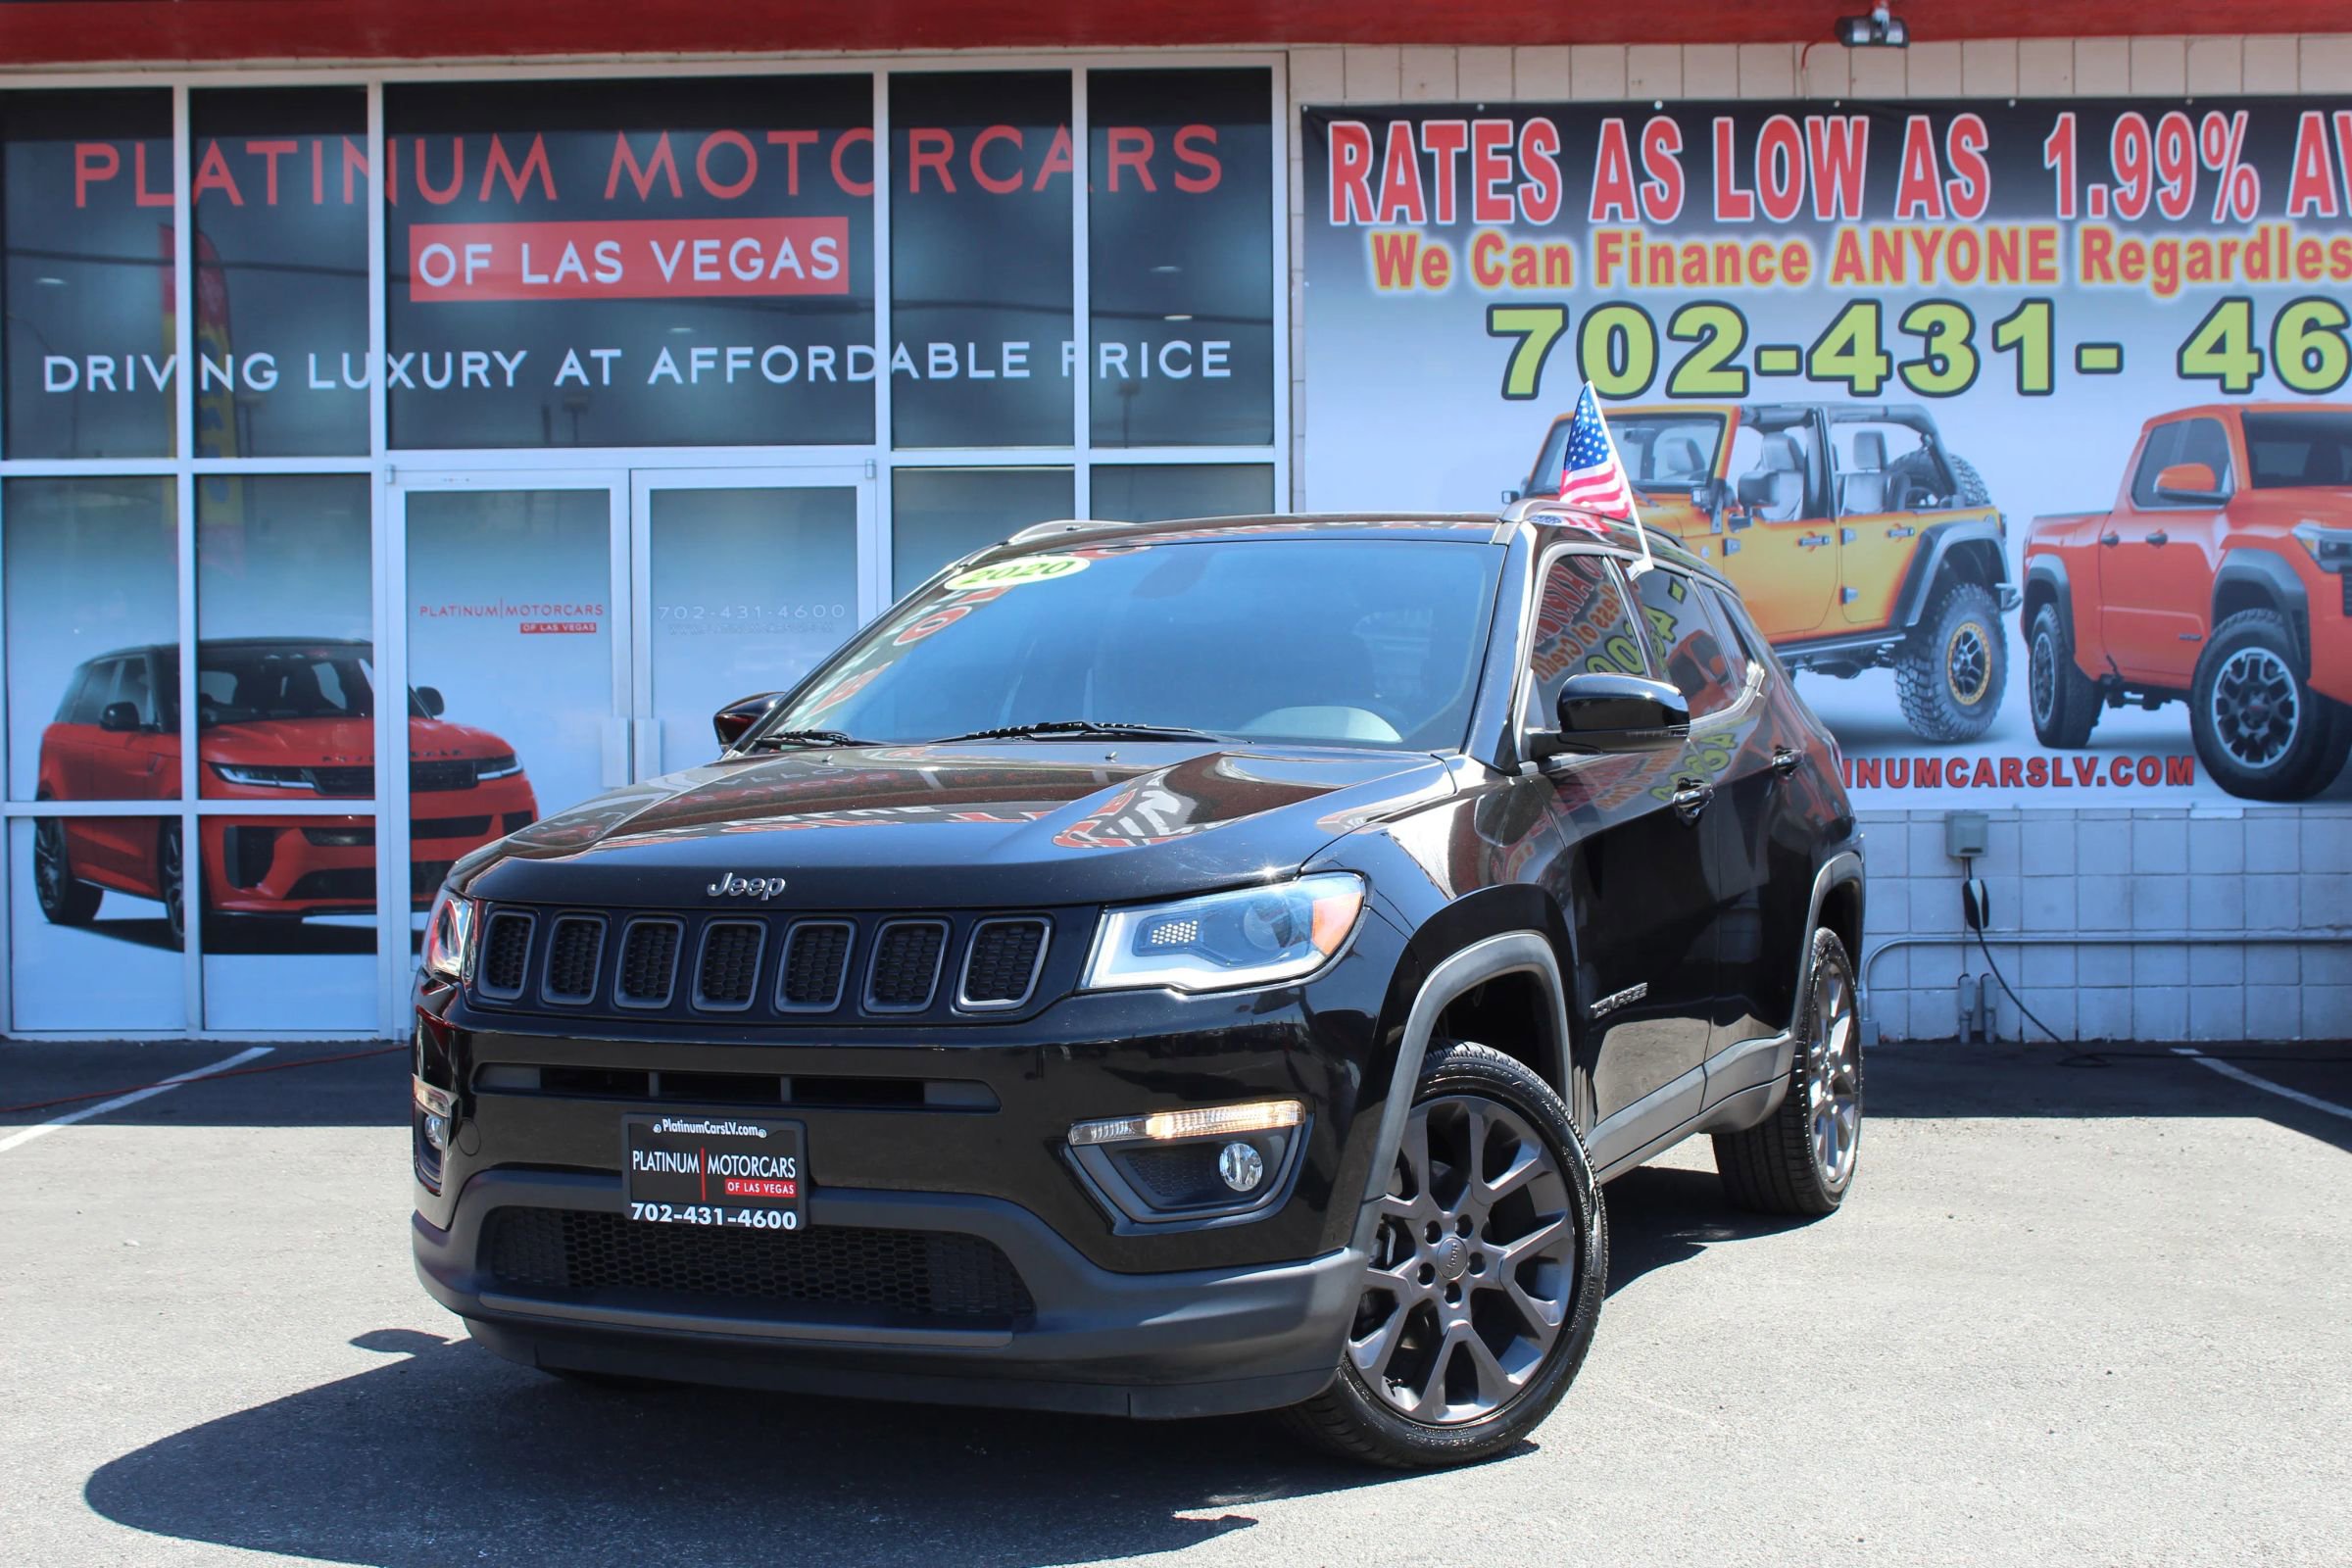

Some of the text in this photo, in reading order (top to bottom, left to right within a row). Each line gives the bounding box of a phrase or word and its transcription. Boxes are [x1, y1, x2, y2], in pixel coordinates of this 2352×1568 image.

[74, 123, 1223, 208] PLATINUM MOTORCARS
[1328, 117, 1563, 225] RATES
[1589, 115, 1685, 224] AS
[1713, 114, 1870, 222] LOW
[1894, 113, 1991, 221] AS
[2044, 111, 2261, 222] 1.99%
[417, 235, 841, 286] OF LAS VEGAS
[1372, 231, 1451, 290] We
[1472, 230, 1574, 288] Can
[1594, 229, 1811, 286] Finance
[1832, 226, 2058, 284] ANYONE
[44, 352, 279, 392] DRIVNG
[309, 350, 528, 390] LUXURY
[554, 347, 622, 386] AT
[648, 341, 1031, 384] AFFORDABLE
[956, 562, 1076, 585] 2020
[419, 603, 604, 617] PLATINUM MOTORCARS
[658, 604, 846, 619] 702-431-4600
[522, 623, 596, 632] OF LAS VEGAS
[1842, 756, 2195, 789] INUMCARSLV.COM
[707, 872, 786, 901] Jeep
[662, 1117, 760, 1137] PlatinumCarsLV.com
[632, 1151, 796, 1179] PLATINUM MOTORCARS
[727, 1181, 795, 1195] OF LAS VEGAS
[631, 1202, 797, 1230] 702-431-4600
